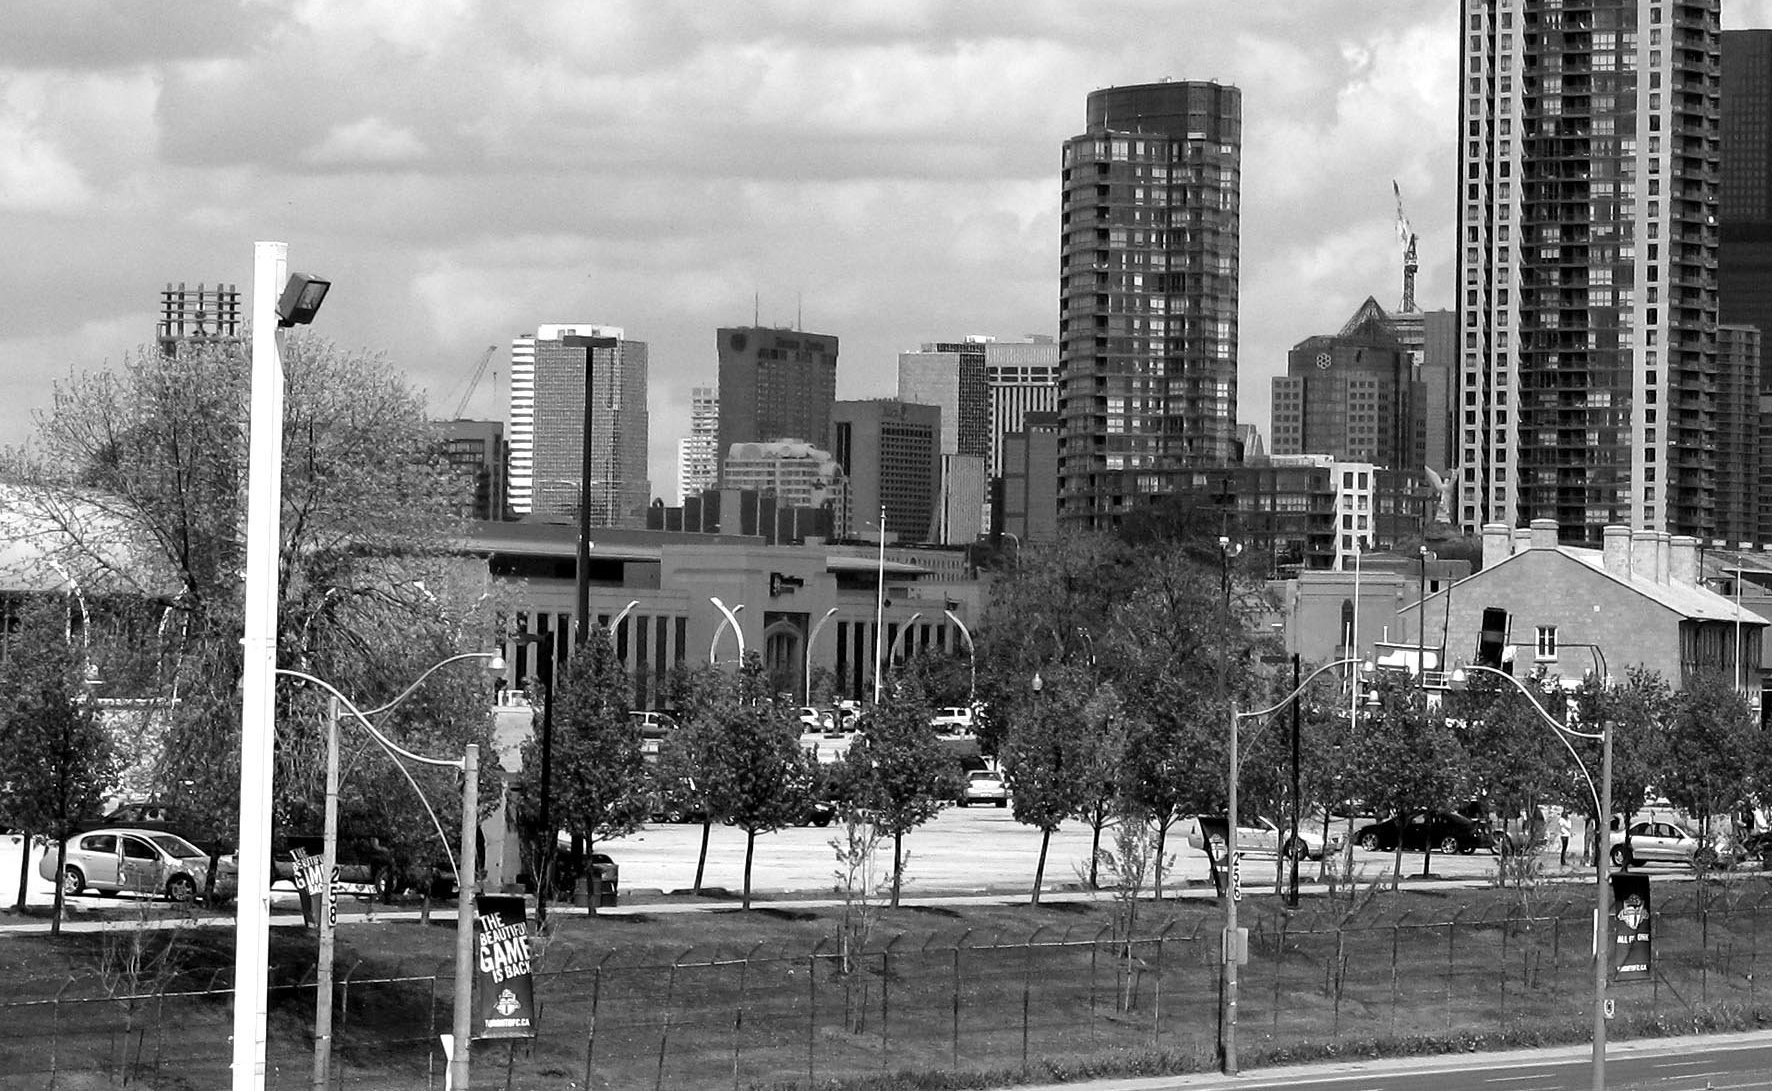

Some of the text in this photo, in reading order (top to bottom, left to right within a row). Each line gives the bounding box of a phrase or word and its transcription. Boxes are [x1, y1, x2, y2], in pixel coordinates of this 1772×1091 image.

[1233, 851, 1241, 898] 256
[330, 866, 339, 924] 258
[479, 911, 505, 931] THE
[480, 935, 531, 973] GAME
[492, 960, 531, 984] IS BACK
